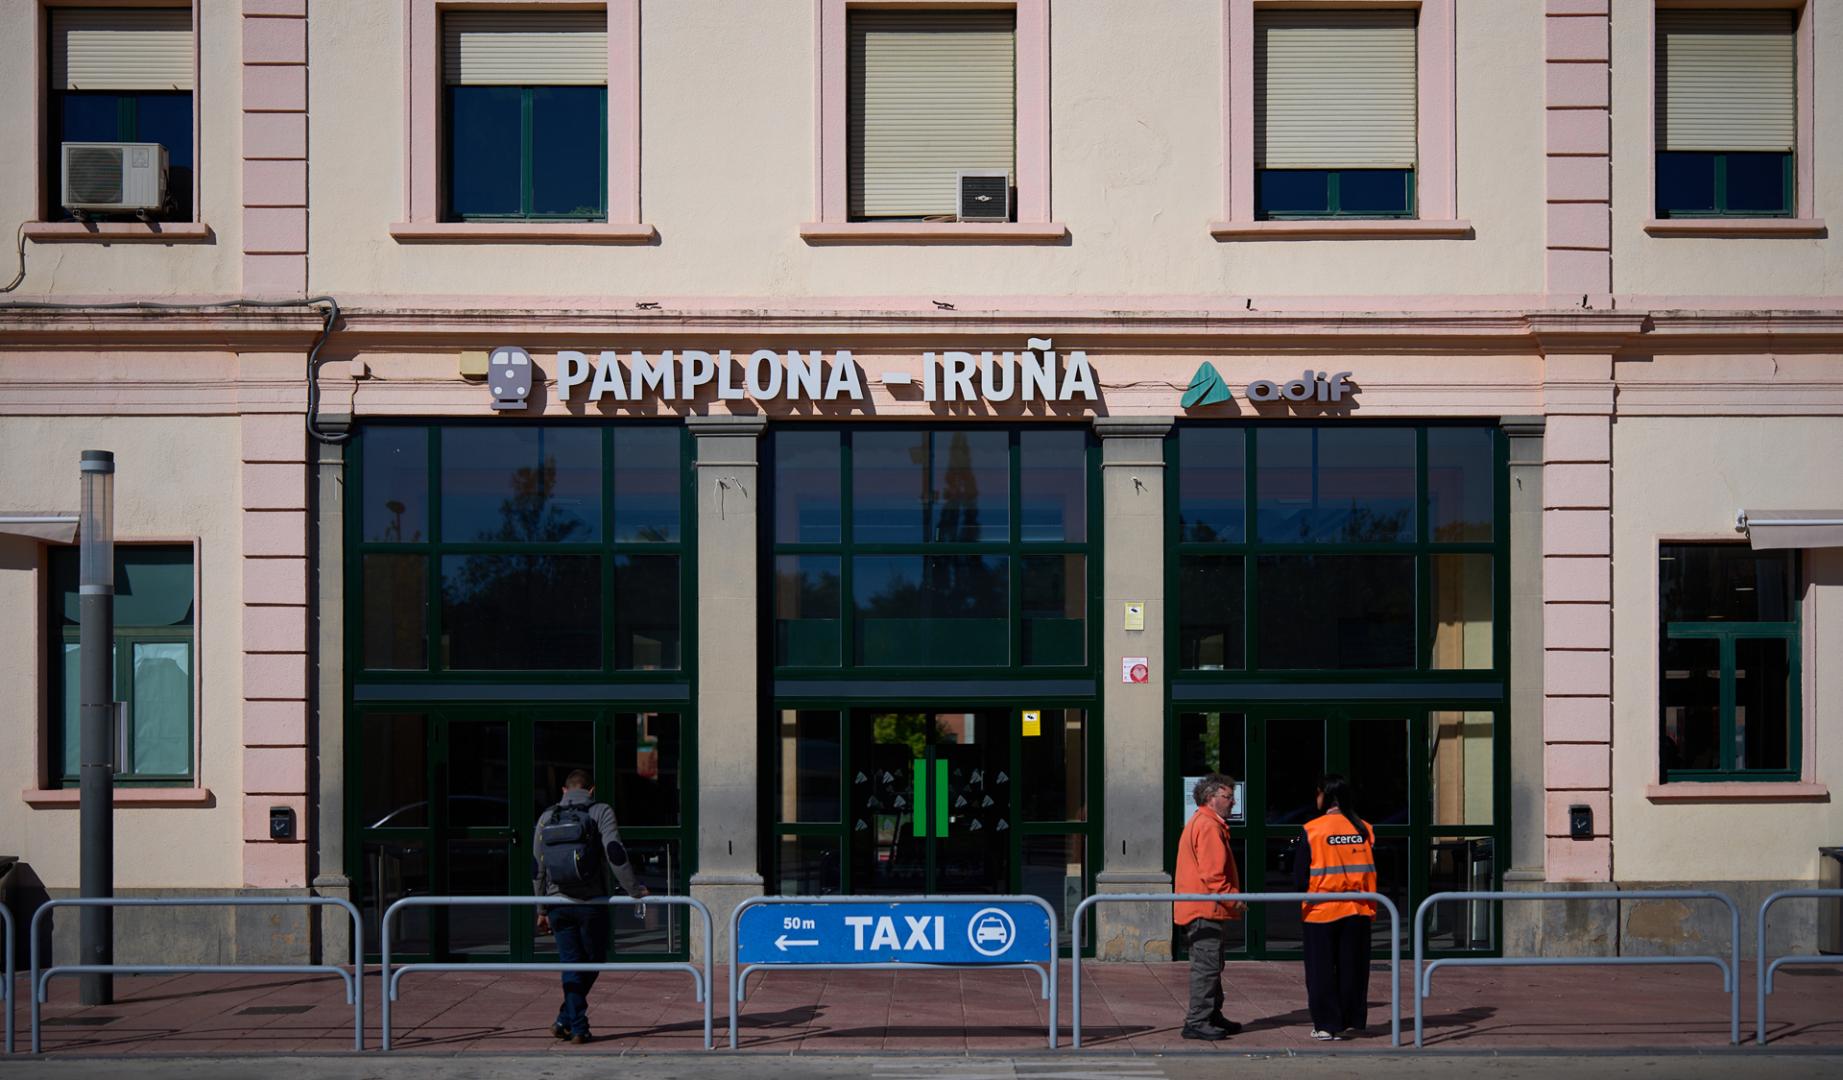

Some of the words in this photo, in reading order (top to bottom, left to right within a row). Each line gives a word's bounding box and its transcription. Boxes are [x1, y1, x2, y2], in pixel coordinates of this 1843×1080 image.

[557, 350, 864, 401] PAMPLONA
[923, 337, 1098, 401] IRUÑA
[1245, 370, 1353, 402] adif
[1329, 835, 1363, 845] acerca
[844, 915, 945, 951] TAXI
